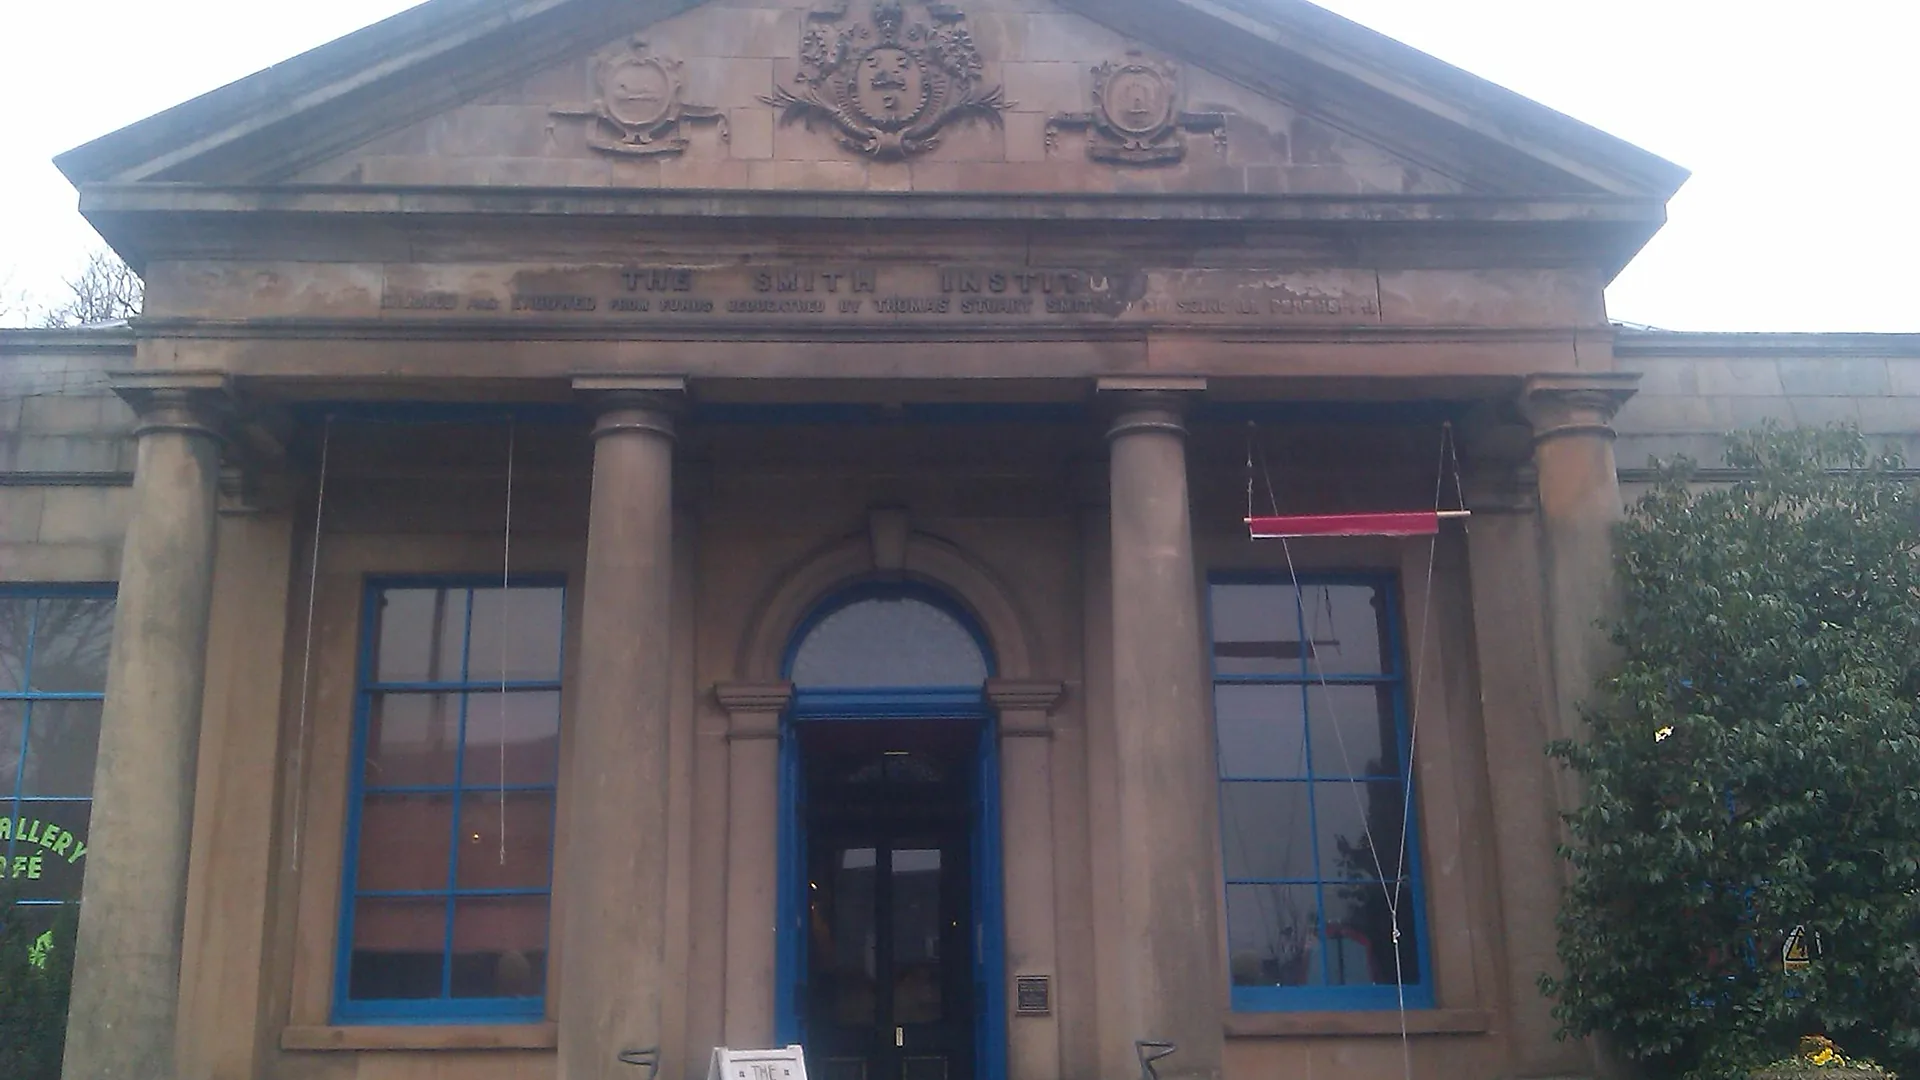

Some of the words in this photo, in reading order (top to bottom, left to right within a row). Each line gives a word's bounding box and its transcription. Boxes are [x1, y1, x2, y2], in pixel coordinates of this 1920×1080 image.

[621, 269, 692, 292] THE
[754, 270, 876, 293] SMITH
[940, 271, 1147, 295] INSTITU
[608, 298, 650, 313] FROM
[659, 298, 715, 313] FUNDS
[838, 299, 863, 313] BY
[873, 297, 951, 313] THOMAS
[961, 297, 1034, 314] STUART
[1046, 297, 1103, 314] SMIT
[751, 1064, 777, 1080] THE
